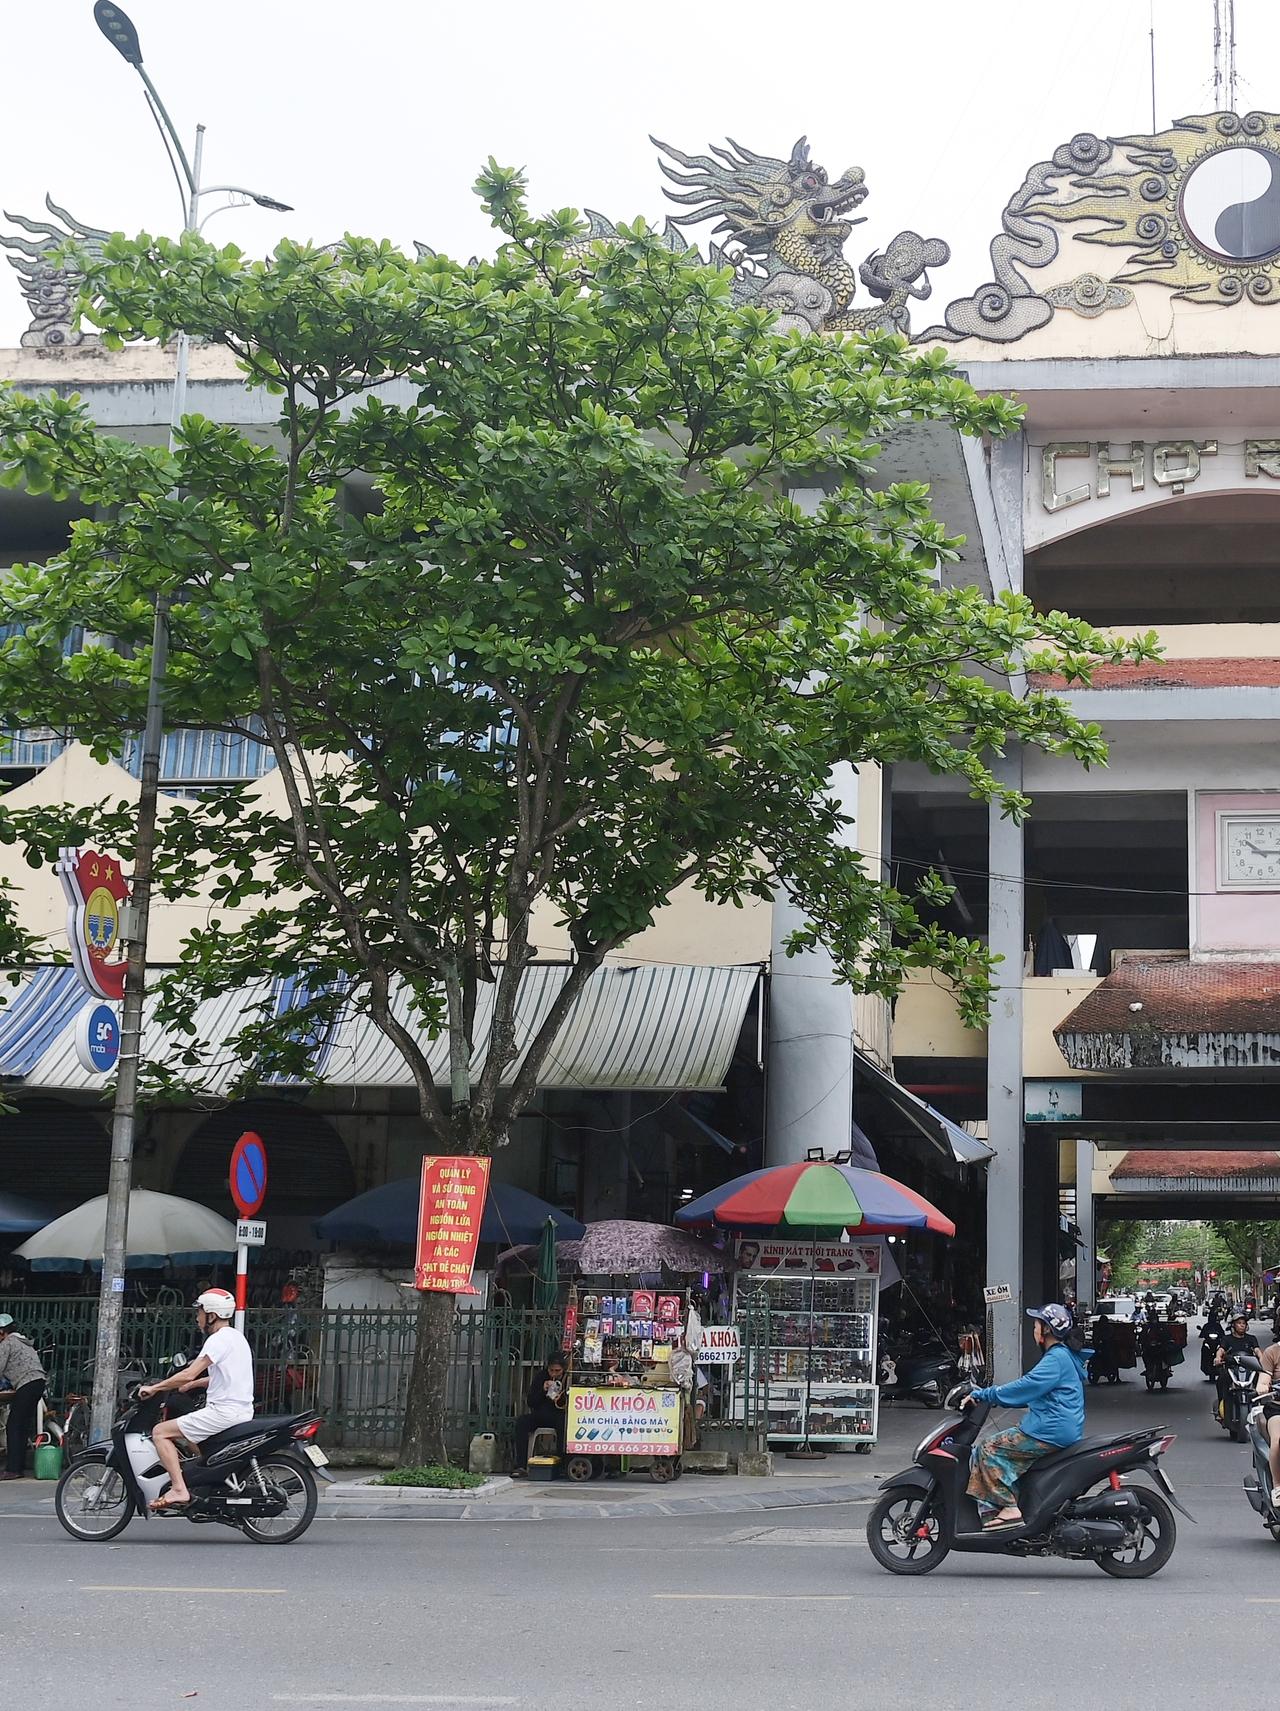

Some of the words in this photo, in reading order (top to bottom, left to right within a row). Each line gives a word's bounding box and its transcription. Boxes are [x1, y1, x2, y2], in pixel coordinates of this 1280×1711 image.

[1042, 440, 1218, 515] CHỢ
[1256, 828, 1264, 836] 12
[435, 1199, 445, 1209] AN
[444, 1245, 460, 1258] CÁC
[826, 1248, 854, 1257] TRANG
[710, 1327, 738, 1347] KHÓA
[574, 1391, 605, 1411] SỬA
[610, 1392, 657, 1412] KHÓA
[577, 1416, 595, 1425] LÀM
[597, 1416, 620, 1425] CHÌA
